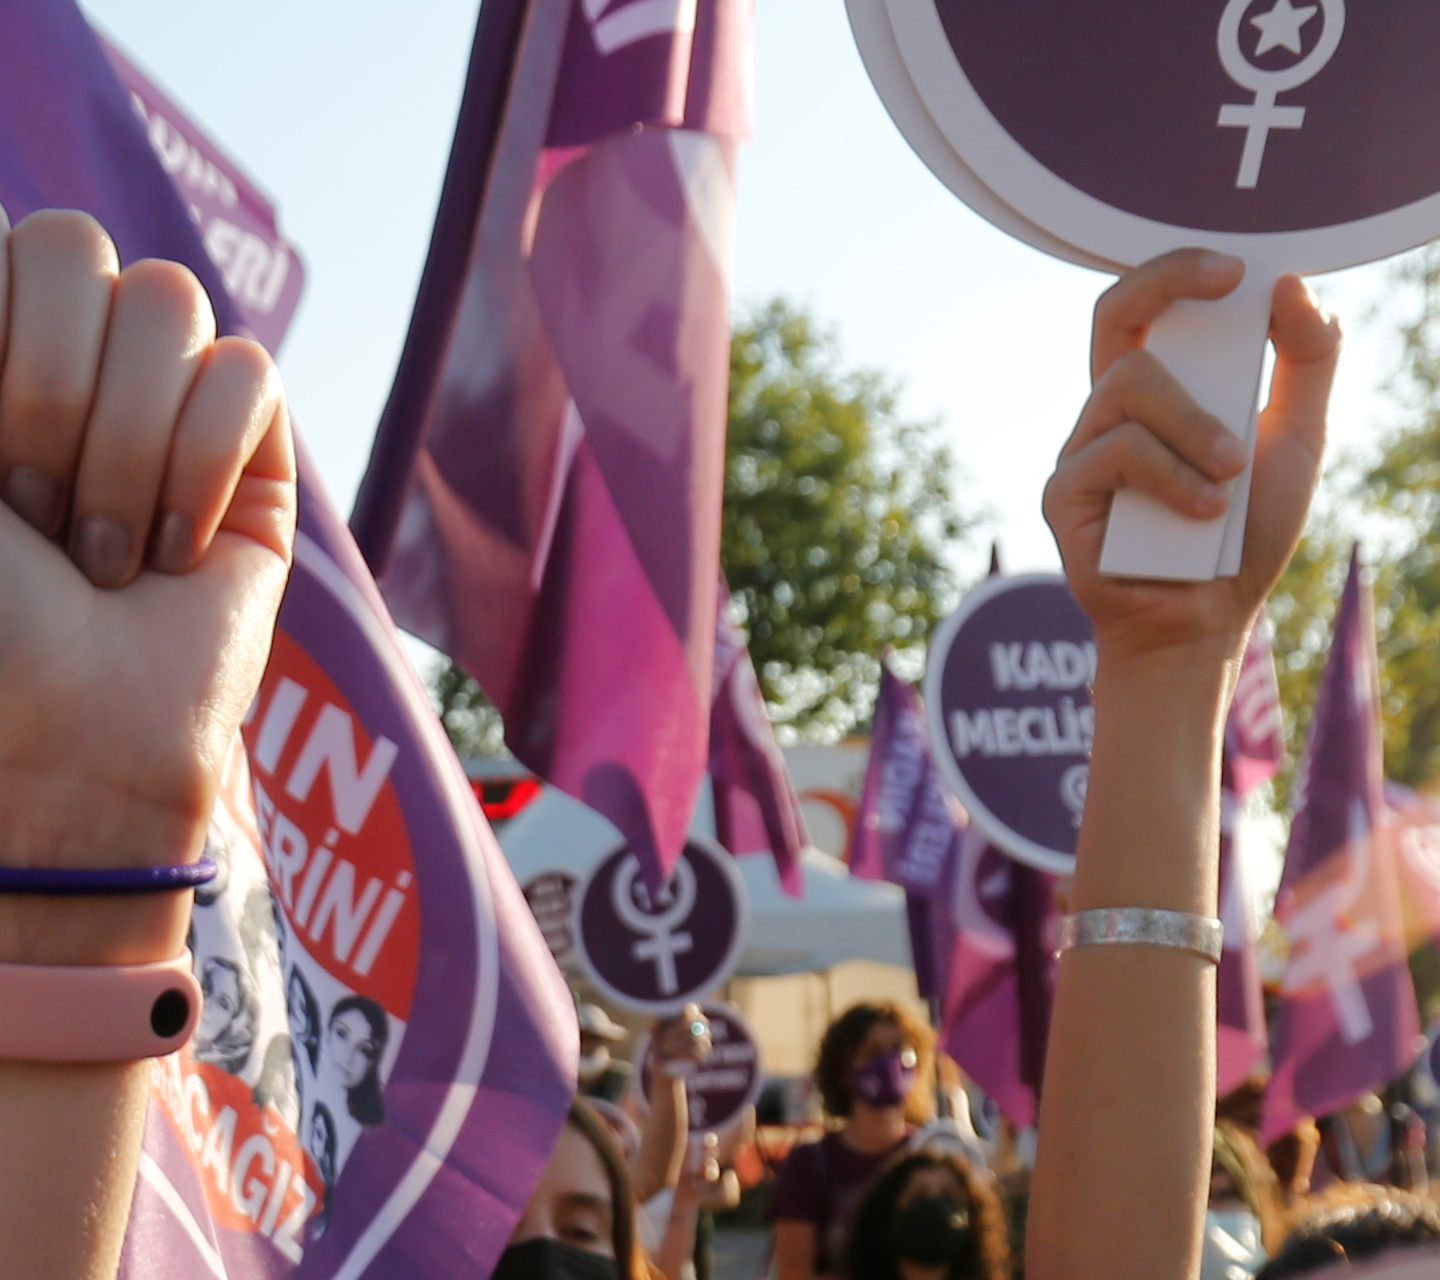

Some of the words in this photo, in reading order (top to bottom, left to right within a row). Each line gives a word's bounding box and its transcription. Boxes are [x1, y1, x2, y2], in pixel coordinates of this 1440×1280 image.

[130, 90, 239, 211] DIN
[190, 203, 290, 316] ERİ
[246, 676, 400, 836] IN
[254, 777, 413, 978] ERİNİ
